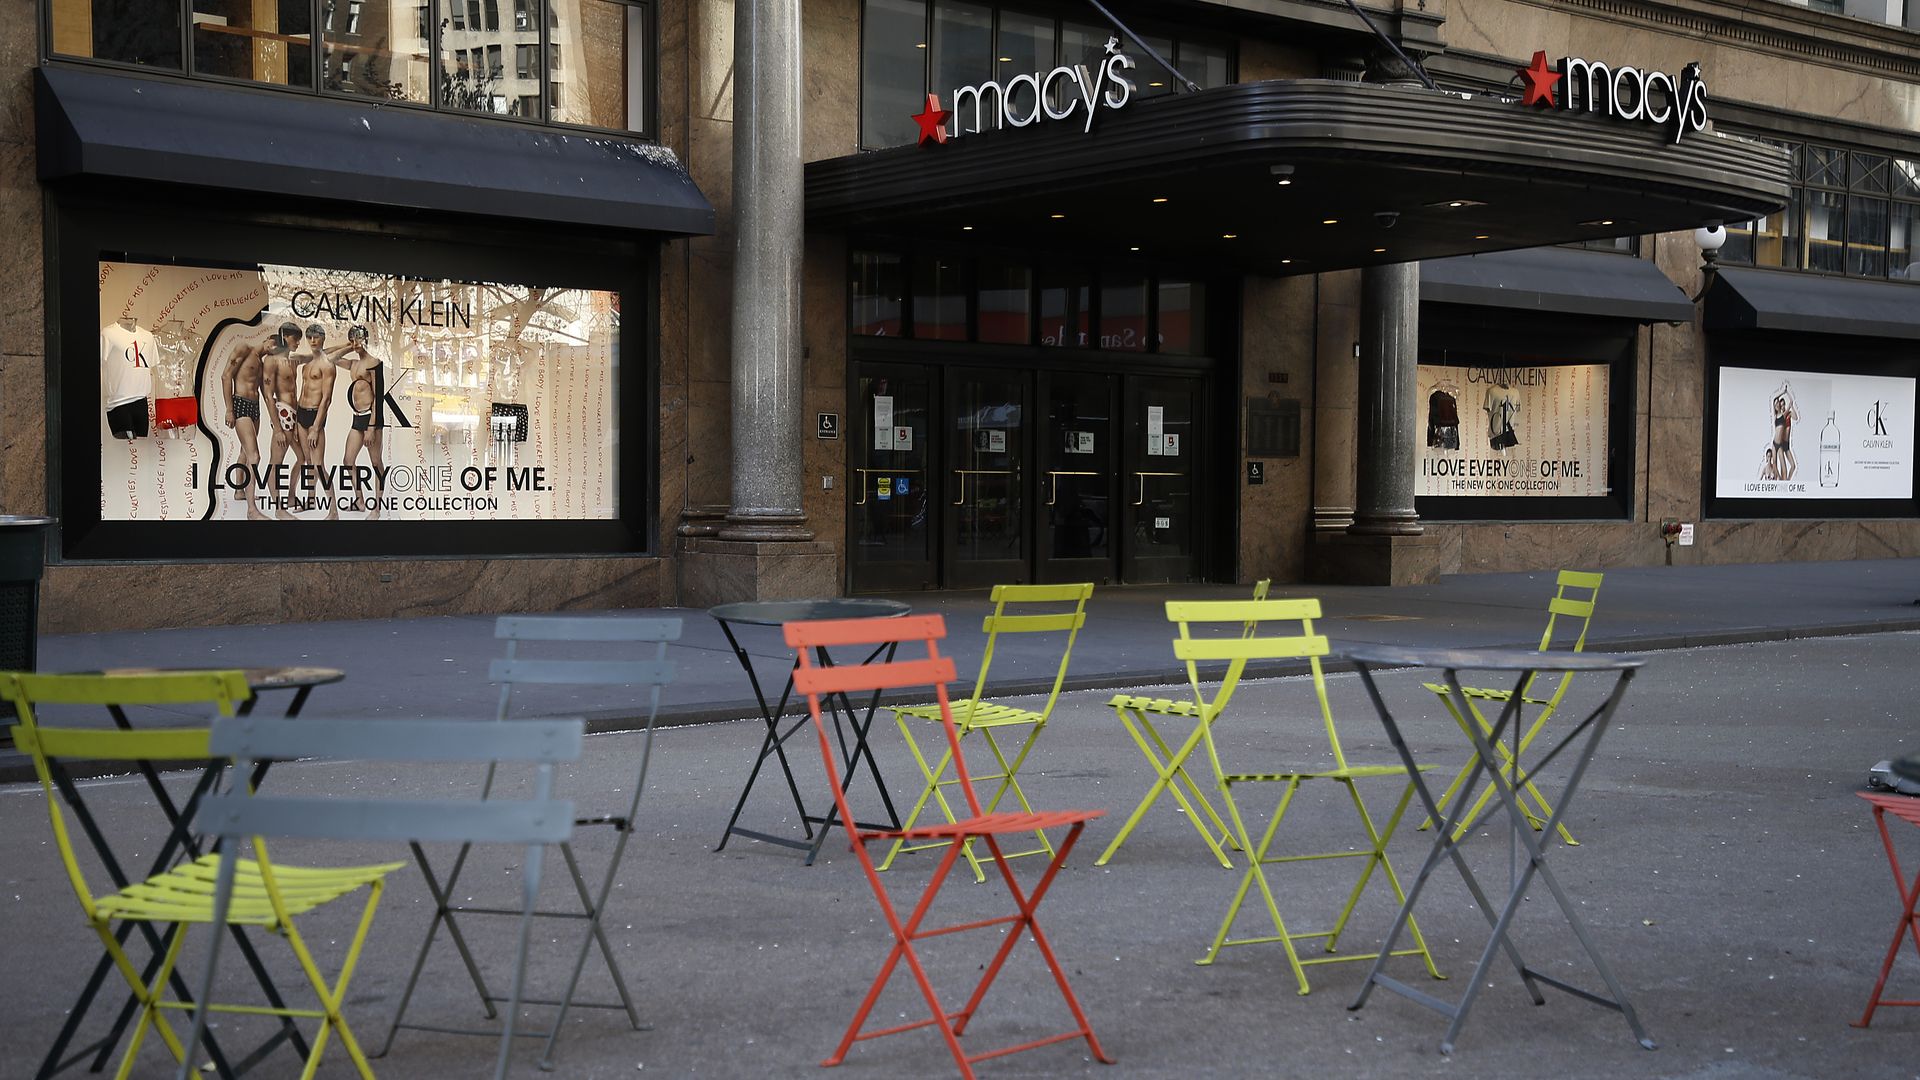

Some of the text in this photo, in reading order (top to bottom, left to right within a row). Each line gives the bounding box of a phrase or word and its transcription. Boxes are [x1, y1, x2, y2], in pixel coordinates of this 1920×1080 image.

[953, 36, 1132, 138] macy's
[1566, 57, 1707, 144] macy's
[214, 288, 260, 308] RESILIENCE
[291, 290, 470, 328] CALVIN KLEIN
[536, 370, 546, 390] BODY
[1467, 367, 1547, 386] CALVIN KLEIN
[156, 440, 166, 462] LOVE
[1862, 440, 1894, 448] CALVIN KLEIN
[130, 448, 138, 470] LOVE
[416, 444, 426, 465] LOVE
[192, 462, 198, 490] I
[301, 464, 452, 492] EVERYONE
[460, 466, 498, 492] OF
[506, 467, 552, 492] ME.
[1431, 458, 1465, 476] LOVE
[1470, 460, 1536, 478] EVERYONE
[1541, 460, 1558, 478] OF
[1562, 461, 1583, 478] ME.
[1452, 480, 1559, 490] THE NEW CK ONE COLLECTION
[1748, 484, 1760, 492] LOVE
[1788, 484, 1796, 492] OF
[184, 492, 194, 505] HIS
[259, 496, 498, 512] THE NEW CK ONE COLLECTION
